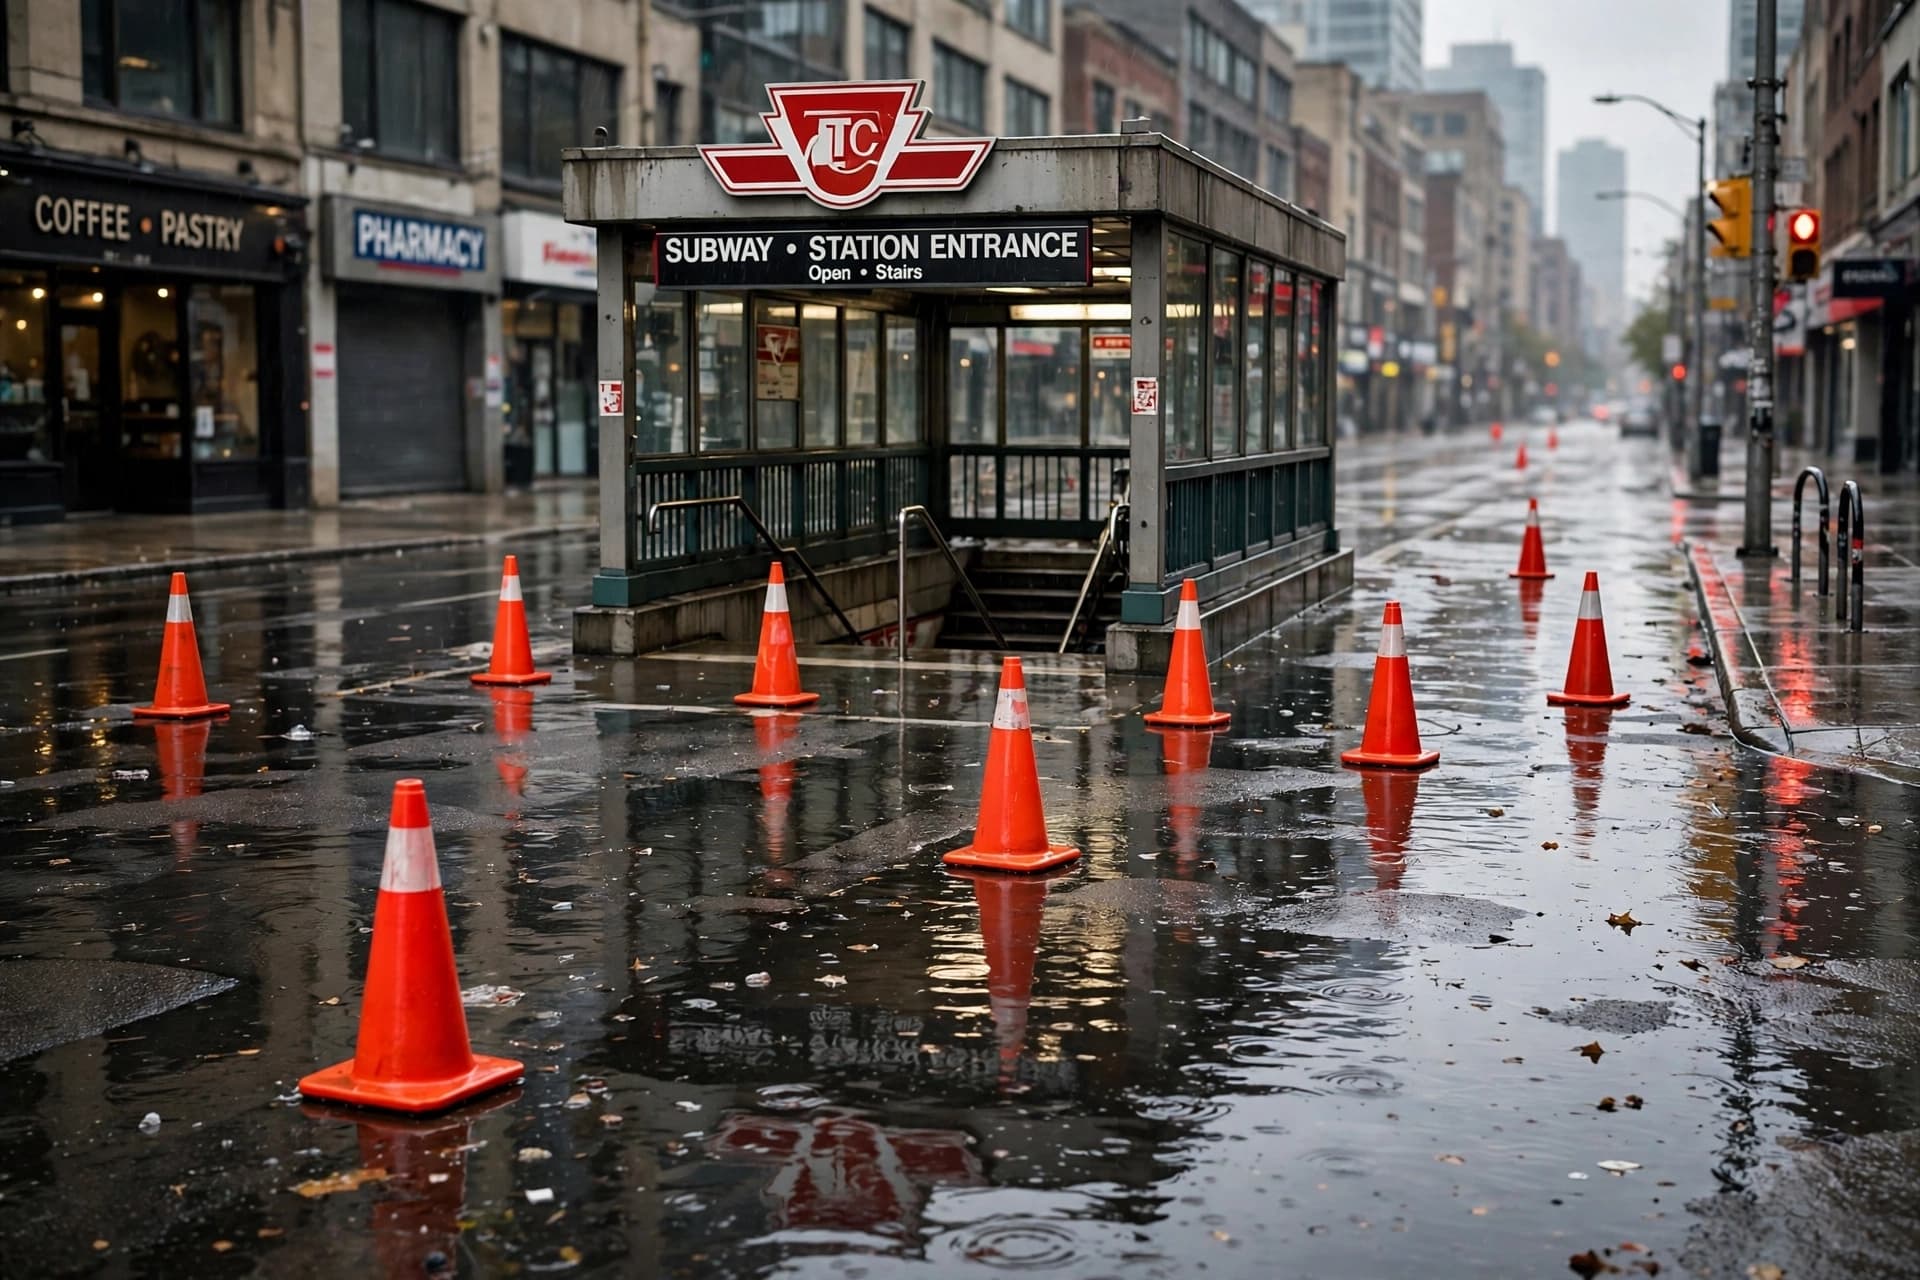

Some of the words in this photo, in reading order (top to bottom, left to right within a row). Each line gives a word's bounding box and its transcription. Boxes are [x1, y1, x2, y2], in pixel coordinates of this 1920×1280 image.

[35, 194, 131, 241] COFFEE
[161, 209, 243, 251] PASTRY
[358, 213, 482, 268] PHARMACY
[665, 236, 774, 264] SUBWAY
[809, 235, 919, 262] STATION
[930, 232, 1079, 259] ENTRANCE
[808, 264, 851, 284] Open
[875, 263, 923, 280] Stairs
